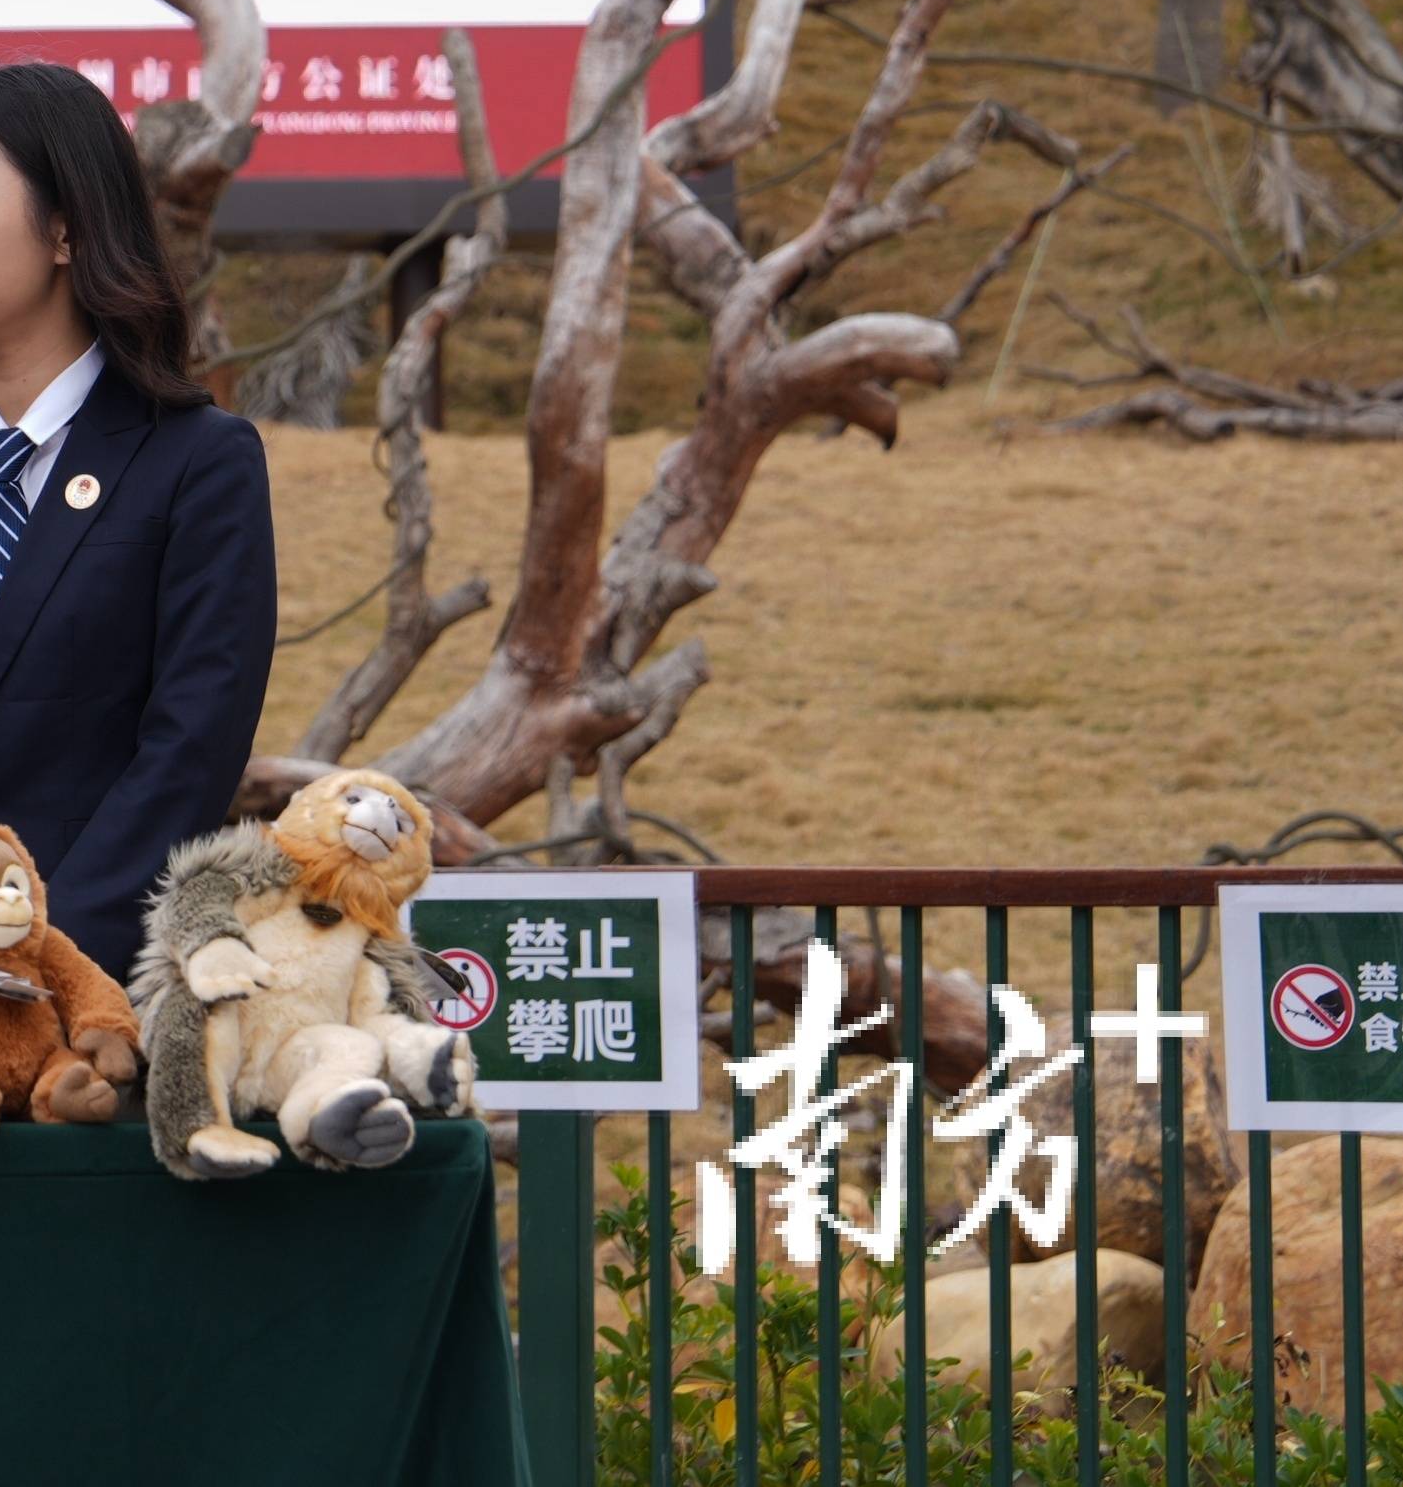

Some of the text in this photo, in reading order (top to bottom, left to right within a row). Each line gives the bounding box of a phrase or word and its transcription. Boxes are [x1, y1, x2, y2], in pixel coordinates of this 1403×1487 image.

[505, 917, 634, 981] 禁止
[1357, 961, 1403, 1002] 禁
[506, 999, 636, 1063] 攀爬
[1359, 1012, 1403, 1053] 食
